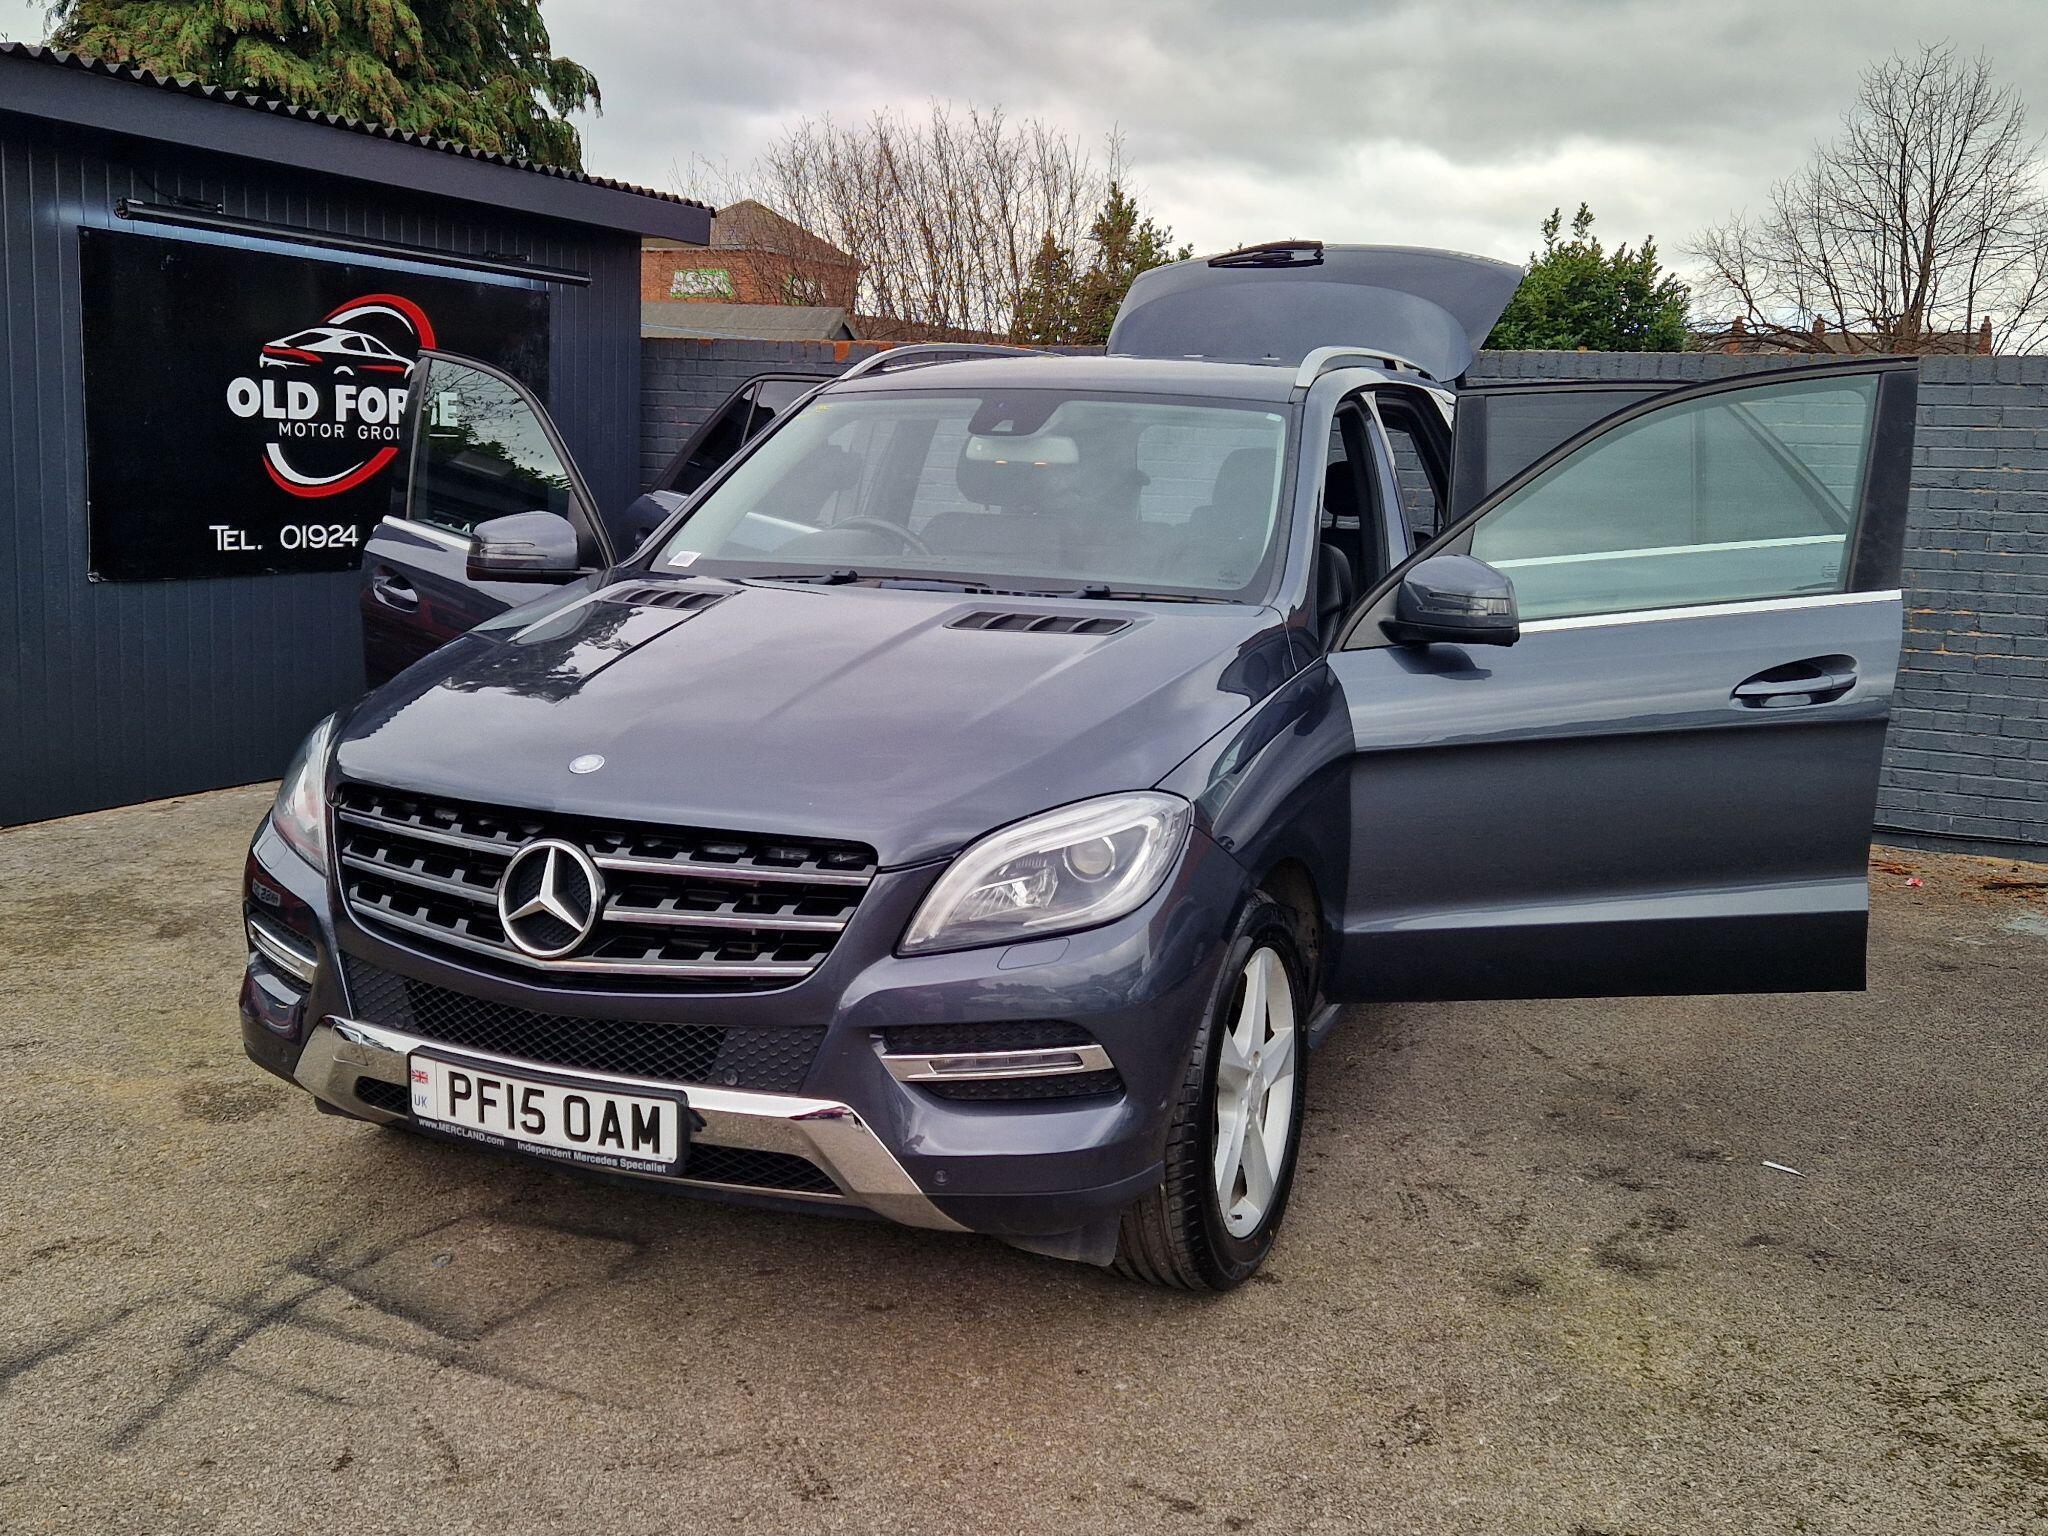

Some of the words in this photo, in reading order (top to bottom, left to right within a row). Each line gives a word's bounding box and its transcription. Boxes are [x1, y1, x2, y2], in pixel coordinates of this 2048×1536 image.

[226, 376, 320, 420] OLD
[334, 384, 459, 428] FORE
[278, 421, 345, 439] MOTOR
[357, 425, 401, 441] GRO
[208, 524, 263, 551] TEL.
[279, 523, 359, 550] 01924
[414, 1094, 428, 1109] UK
[447, 1070, 546, 1136] PF15
[562, 1094, 661, 1155] OAM
[418, 1118, 505, 1147] www.MERCLAND.com
[517, 1141, 572, 1160] Independent
[573, 1151, 618, 1167] Mercedes
[619, 1158, 667, 1174] Specialist
